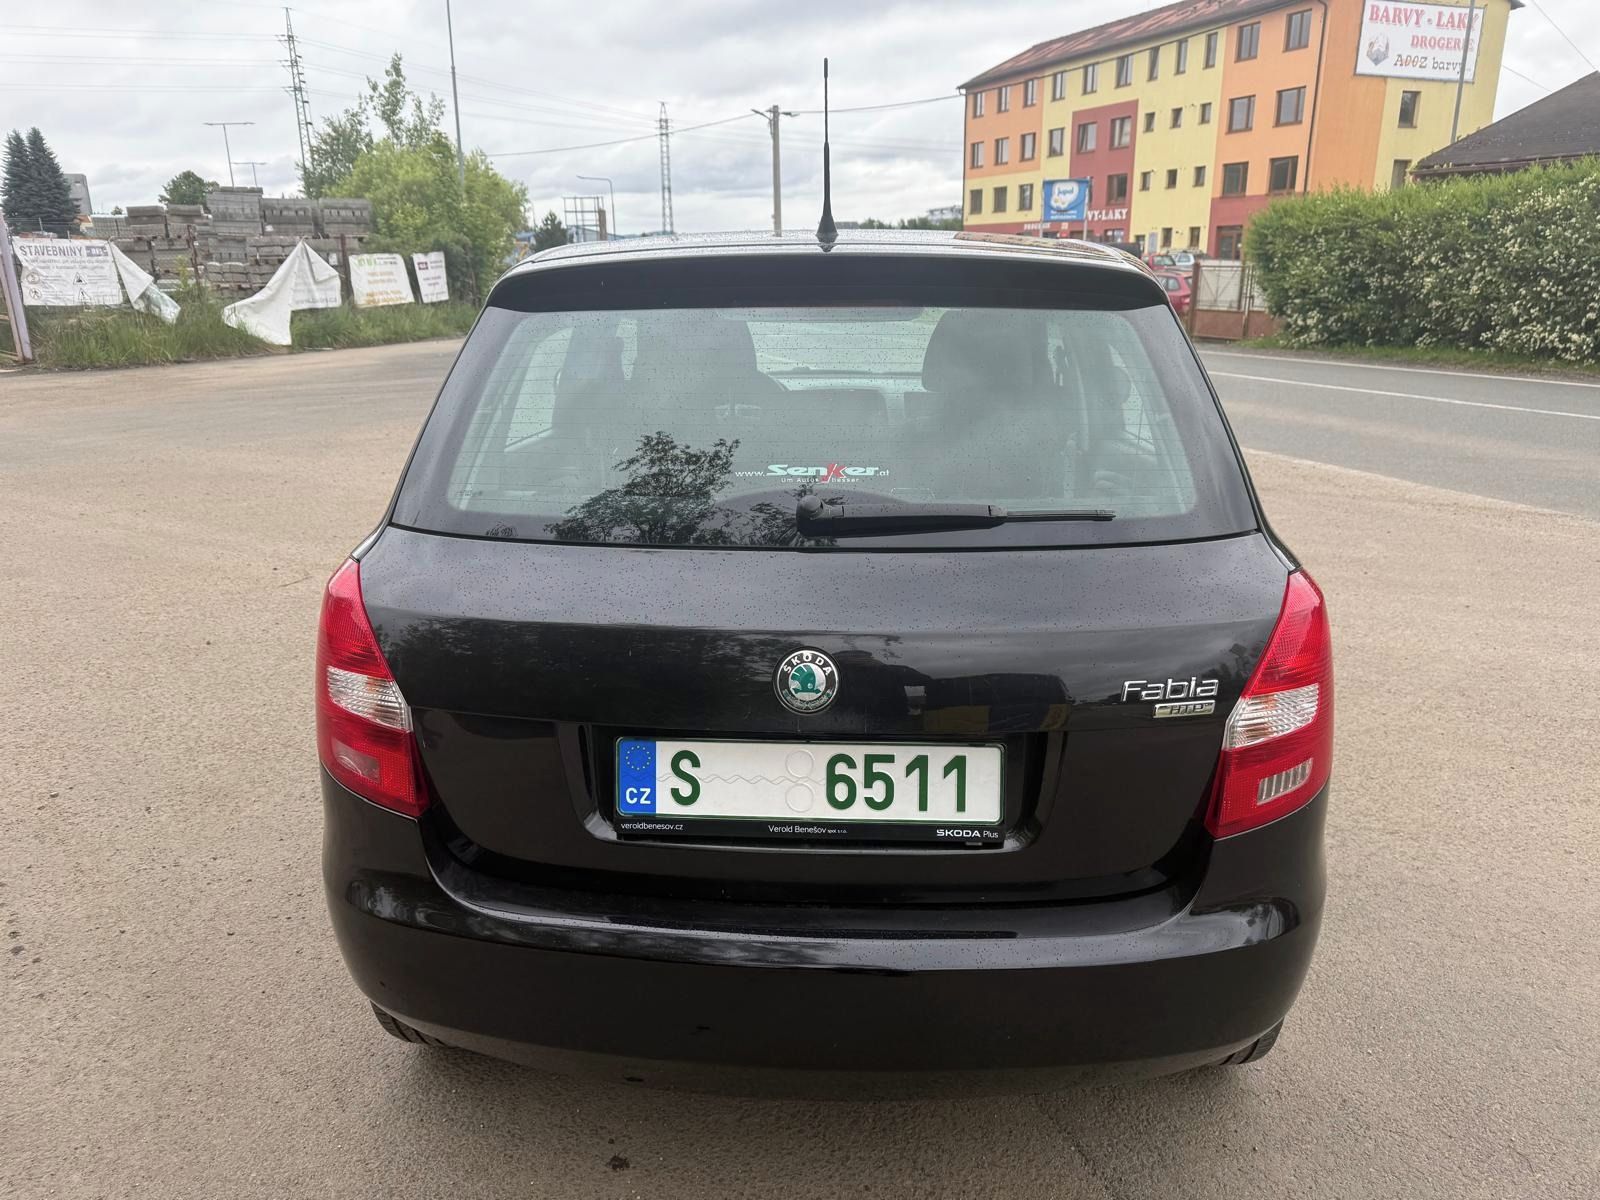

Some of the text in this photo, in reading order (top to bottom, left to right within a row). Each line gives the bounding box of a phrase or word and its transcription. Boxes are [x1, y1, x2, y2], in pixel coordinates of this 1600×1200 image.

[1368, 4, 1425, 27] BARVY
[1410, 34, 1475, 52] DROGERE
[20, 245, 83, 257] STAVEBNINY
[1121, 676, 1219, 702] Fabia
[670, 749, 967, 813] S 6511
[625, 788, 651, 804] CZ
[620, 822, 683, 831] veroldbenesov.cz
[768, 825, 793, 833] Verold
[795, 825, 827, 834] Benešov
[983, 830, 999, 839] Plus
